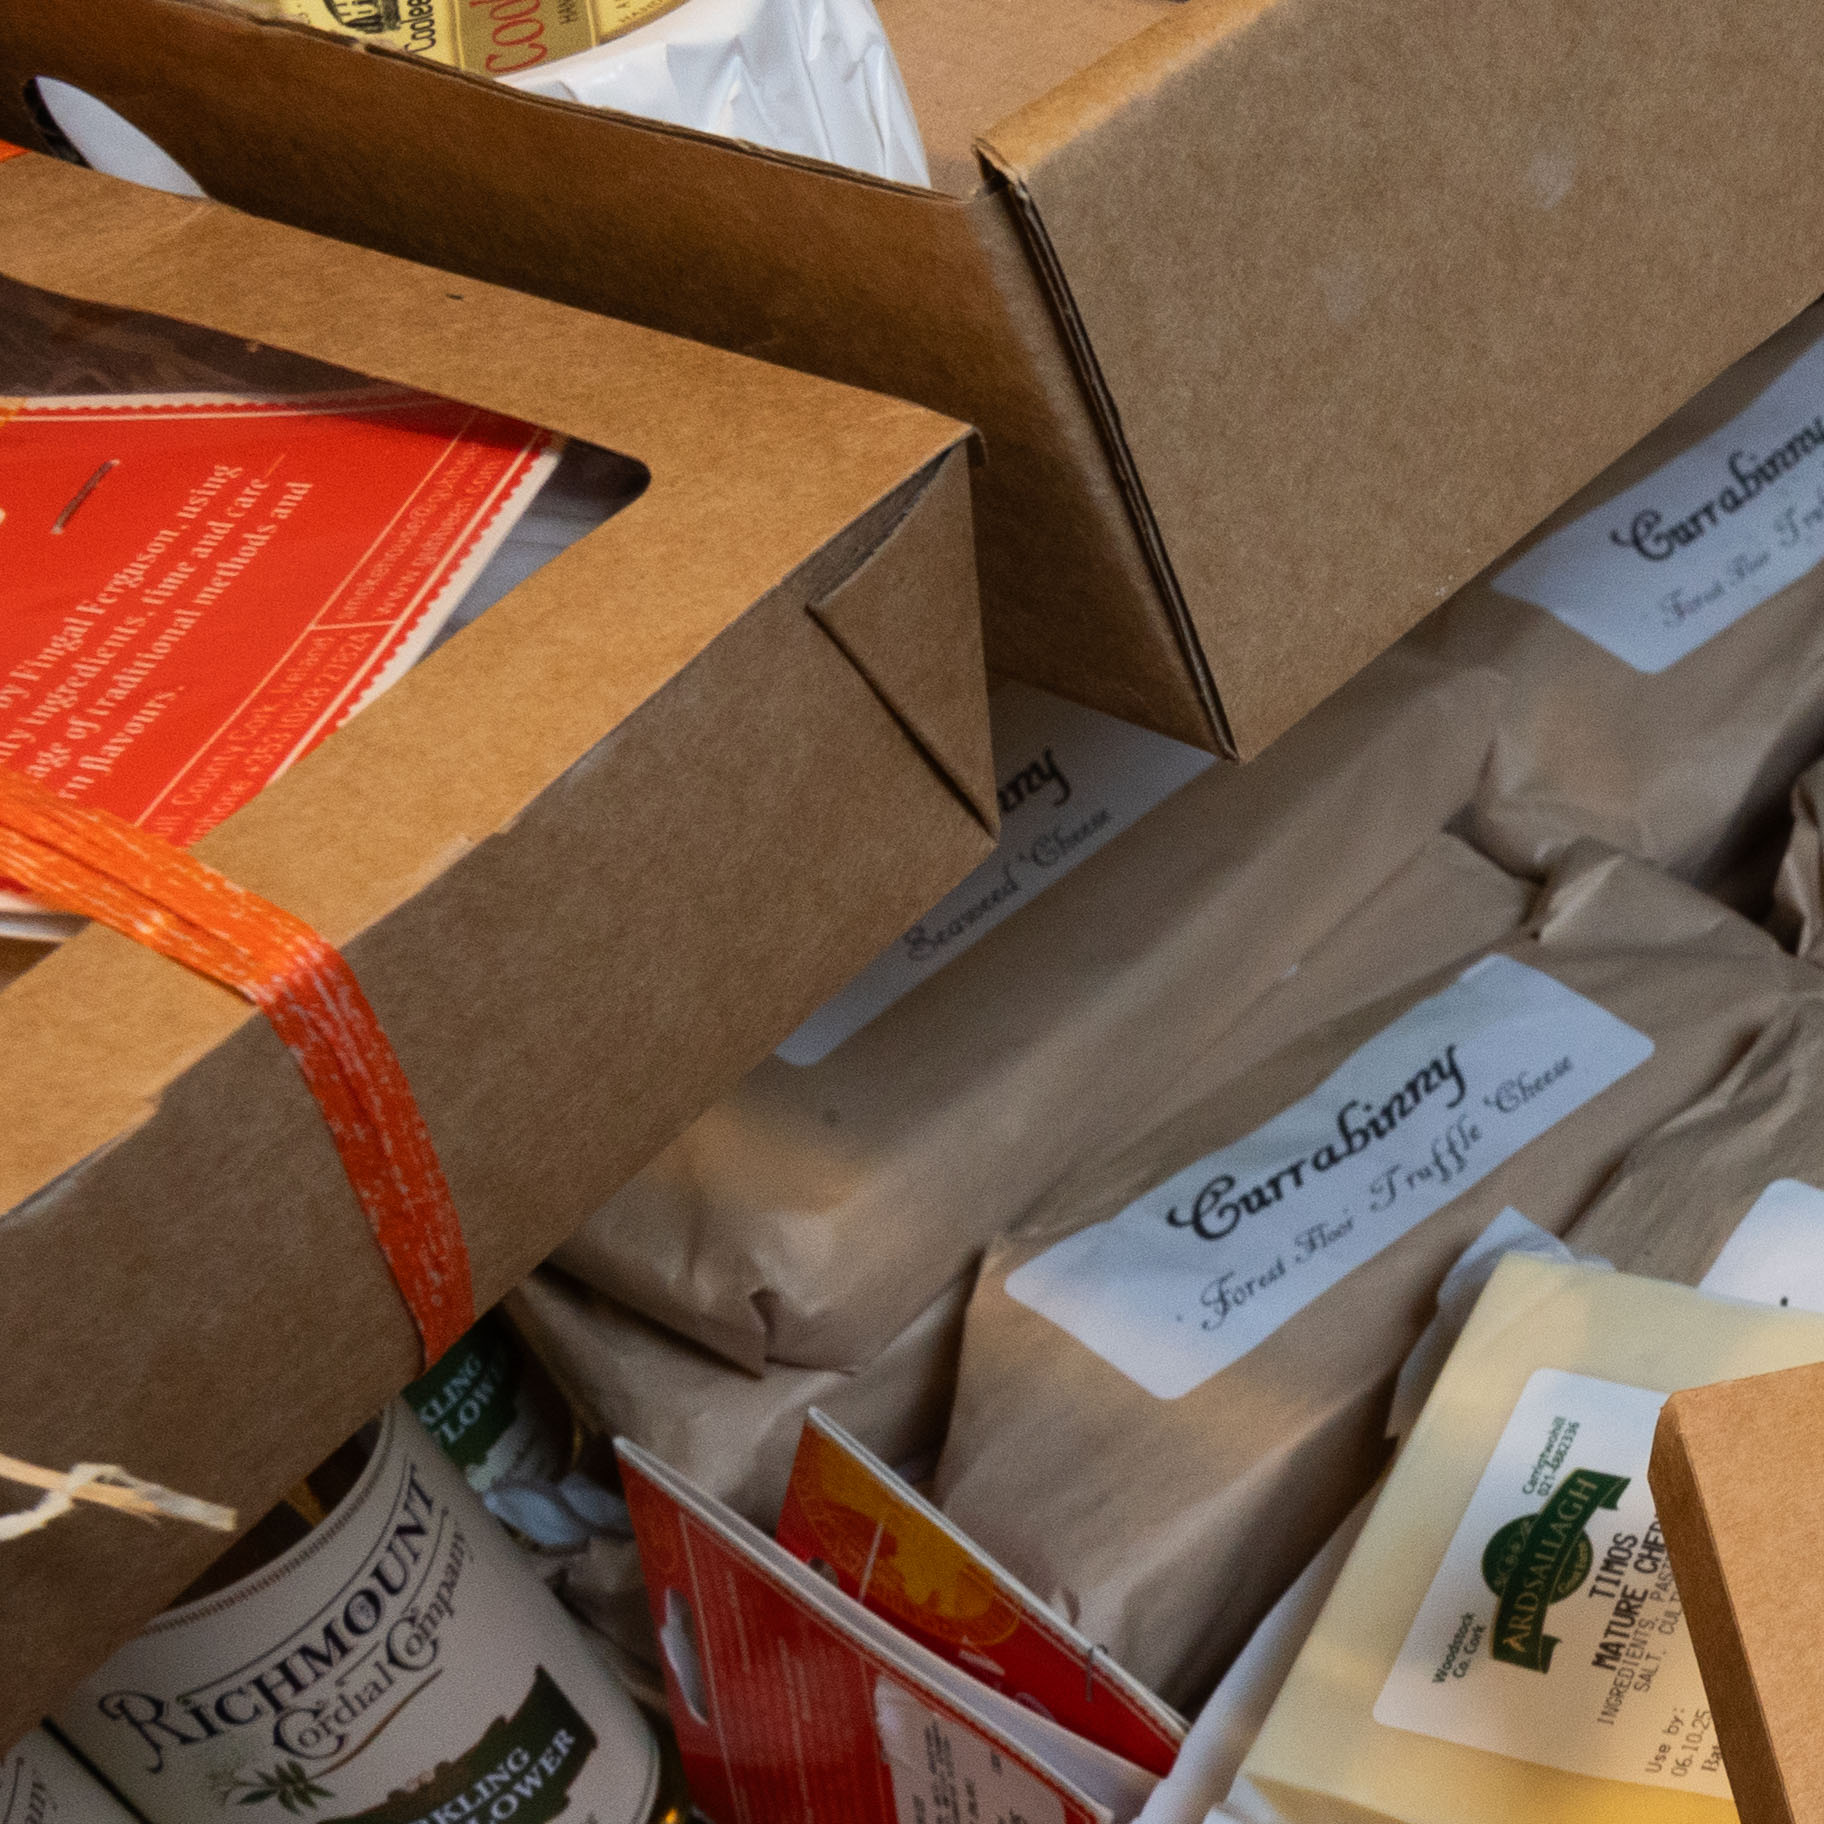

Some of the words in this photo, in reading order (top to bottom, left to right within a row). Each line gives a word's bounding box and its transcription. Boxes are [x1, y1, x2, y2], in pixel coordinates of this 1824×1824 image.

[10, 617, 94, 693] Fingal
[78, 521, 189, 617] Ferguson,
[178, 463, 243, 523] using
[31, 609, 154, 725] ingredients,
[141, 559, 198, 609] time
[192, 520, 236, 561] and
[66, 714, 96, 742] of
[94, 607, 203, 714] traditional
[192, 521, 279, 607] methods
[270, 480, 315, 523] and
[1017, 806, 1115, 873] Cheese
[1166, 1044, 1469, 1245] Currabinny
[1198, 1256, 1289, 1333] Forest
[1369, 1122, 1486, 1213] Truffle
[1481, 1054, 1577, 1116] Cheese
[97, 1466, 448, 1778] RICHMOUNT
[271, 1666, 394, 1761] Cordial
[385, 1522, 477, 1675] Company
[1432, 1611, 1476, 1685] Woodstock
[1452, 1652, 1468, 1679] Co.
[1463, 1624, 1487, 1653] Cork
[1502, 1477, 1599, 1652] ARDSALLAGH
[1588, 1532, 1639, 1601] TIMOS
[1591, 1587, 1649, 1672] MATURE
[1646, 1742, 1671, 1774] Use
[1667, 1706, 1687, 1738] by:
